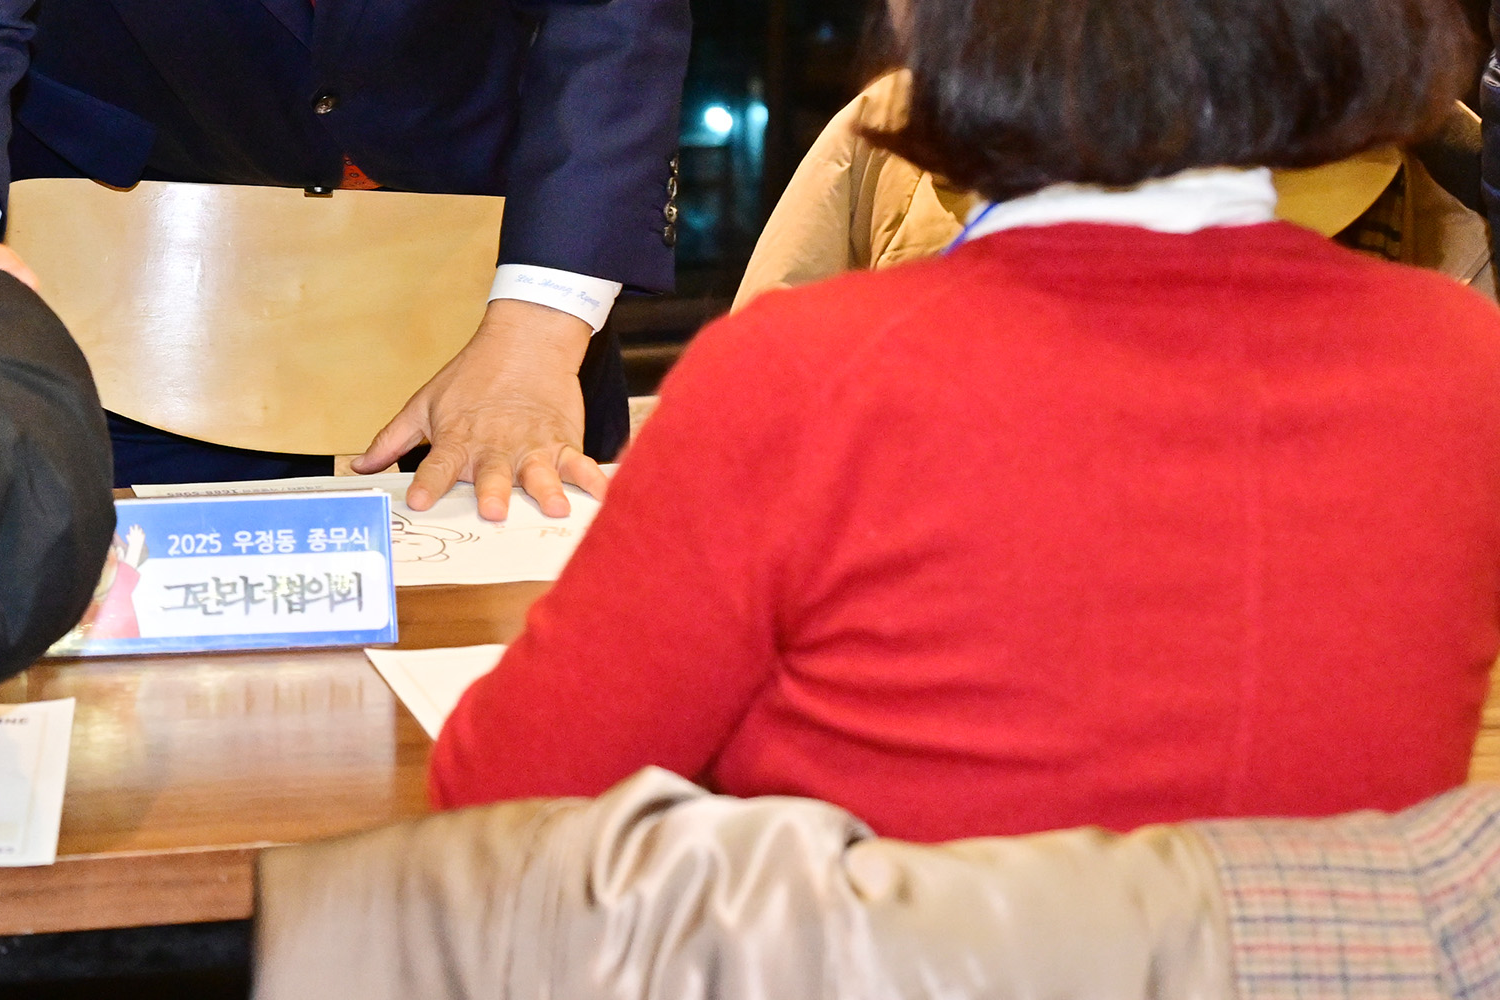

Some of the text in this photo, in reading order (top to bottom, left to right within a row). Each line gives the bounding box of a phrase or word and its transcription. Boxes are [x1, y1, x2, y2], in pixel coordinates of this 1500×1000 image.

[167, 526, 370, 556] 2025 우정동 종무식
[160, 571, 364, 616] 그린리더협의회
